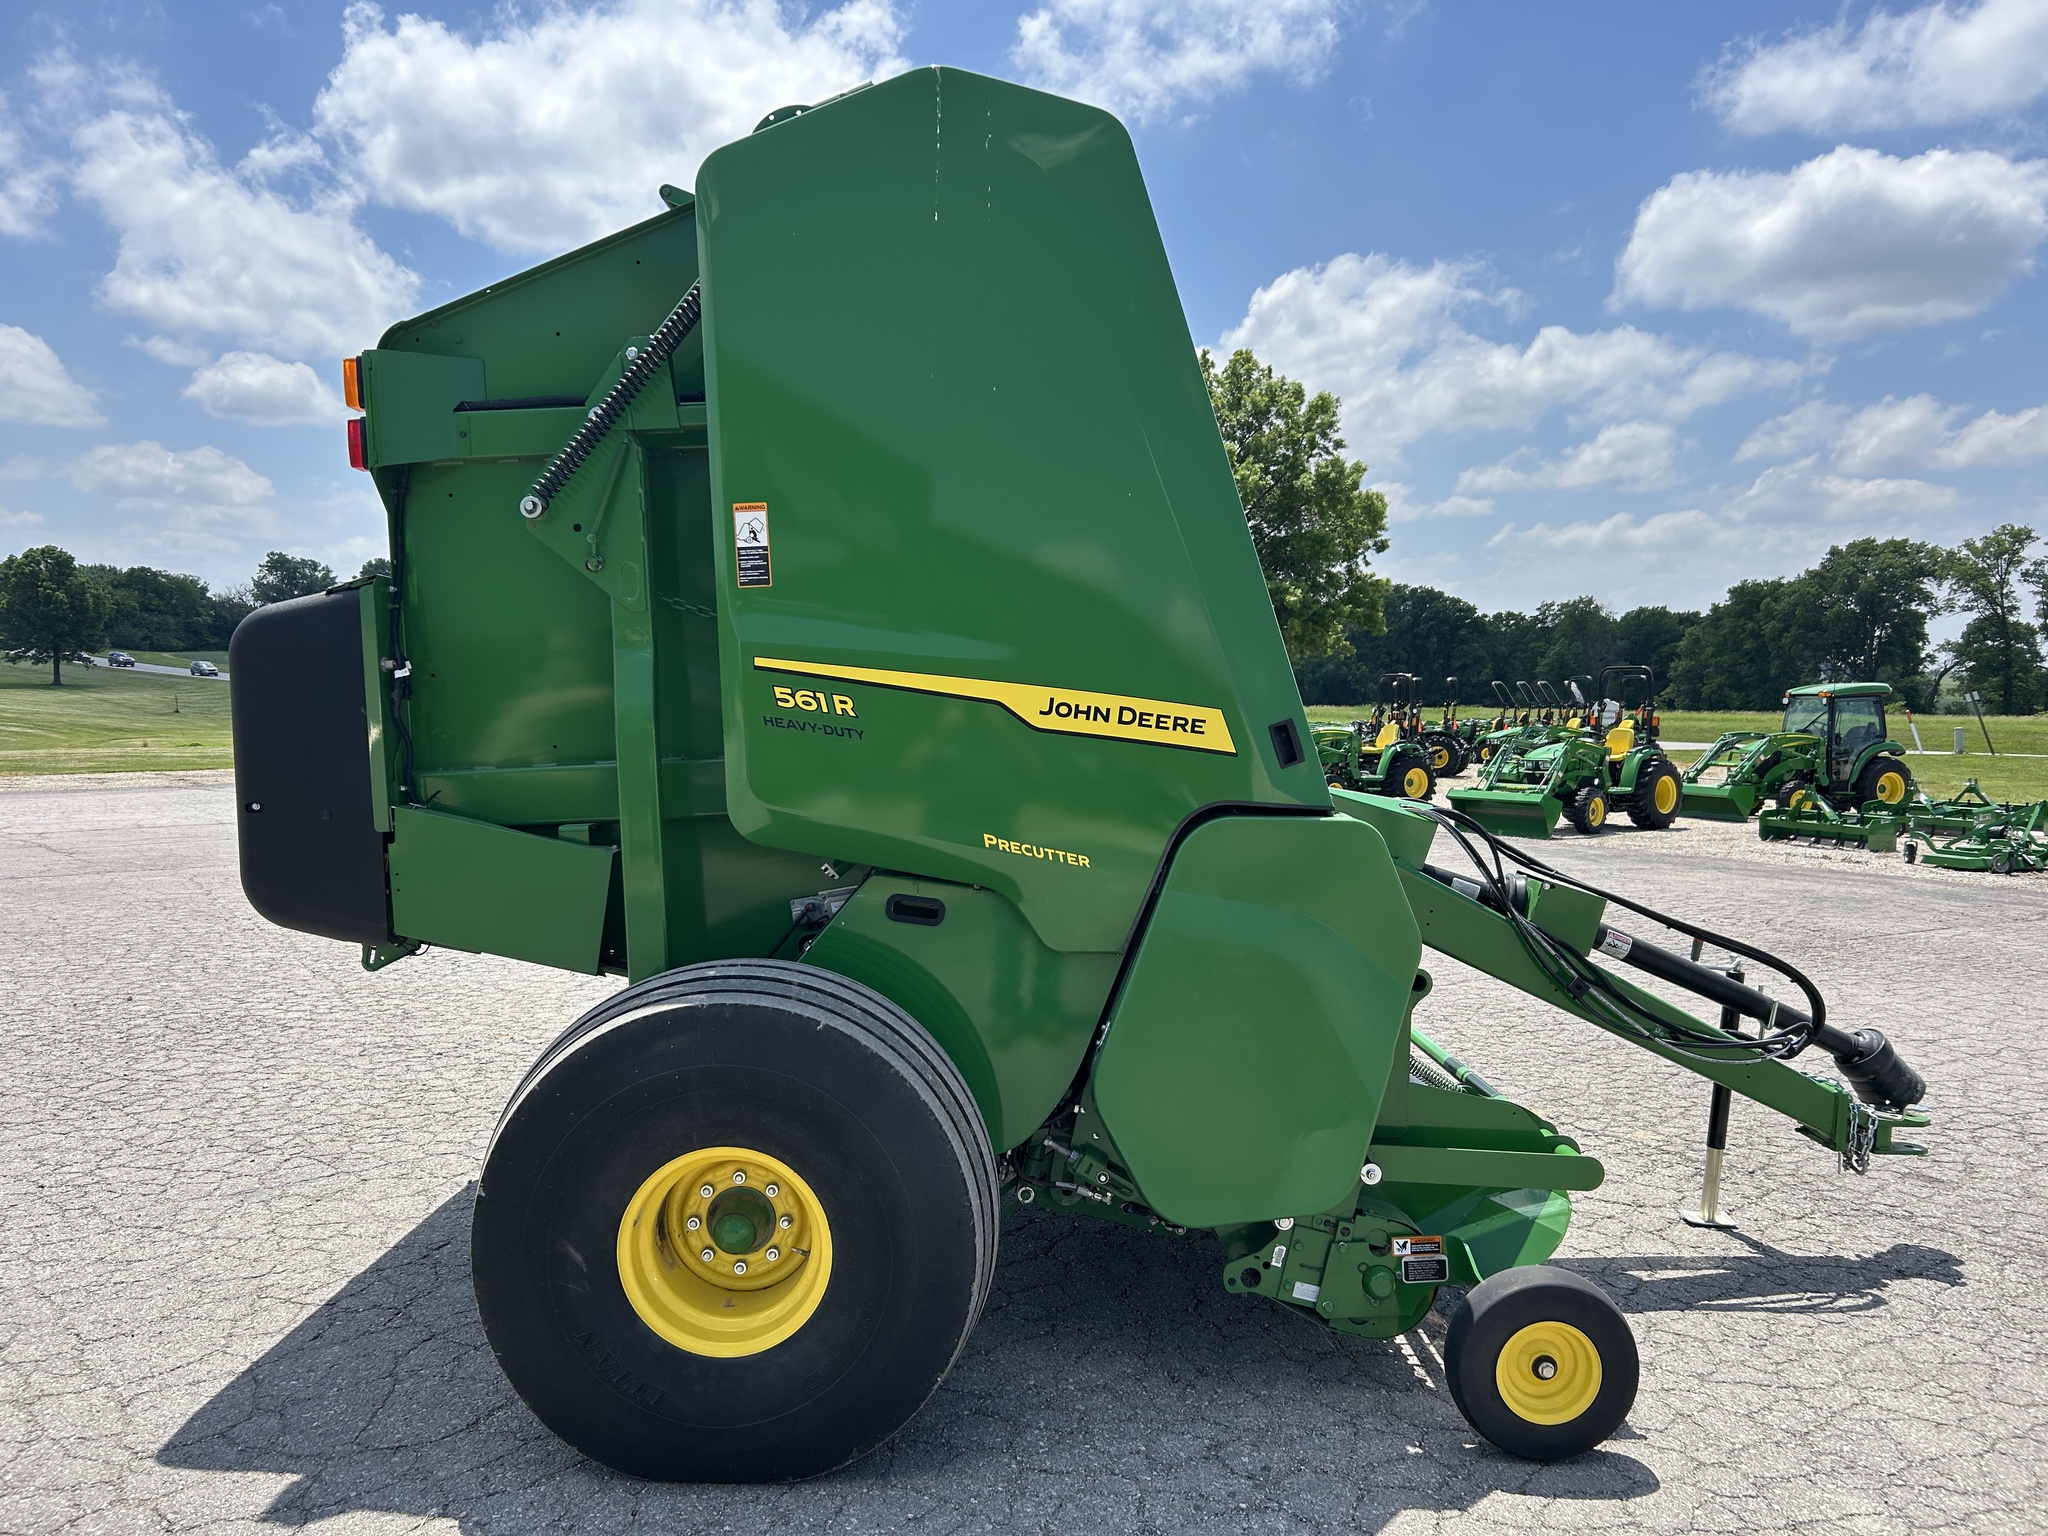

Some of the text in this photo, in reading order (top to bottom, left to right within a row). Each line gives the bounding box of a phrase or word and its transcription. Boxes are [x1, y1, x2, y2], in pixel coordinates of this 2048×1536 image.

[772, 684, 860, 719] 561 R
[1039, 697, 1207, 735] JOHN DEERE
[763, 715, 864, 740] HEAVY-DUTY
[983, 833, 1091, 868] PRECUTTER
[572, 1329, 673, 1414] TITAN
